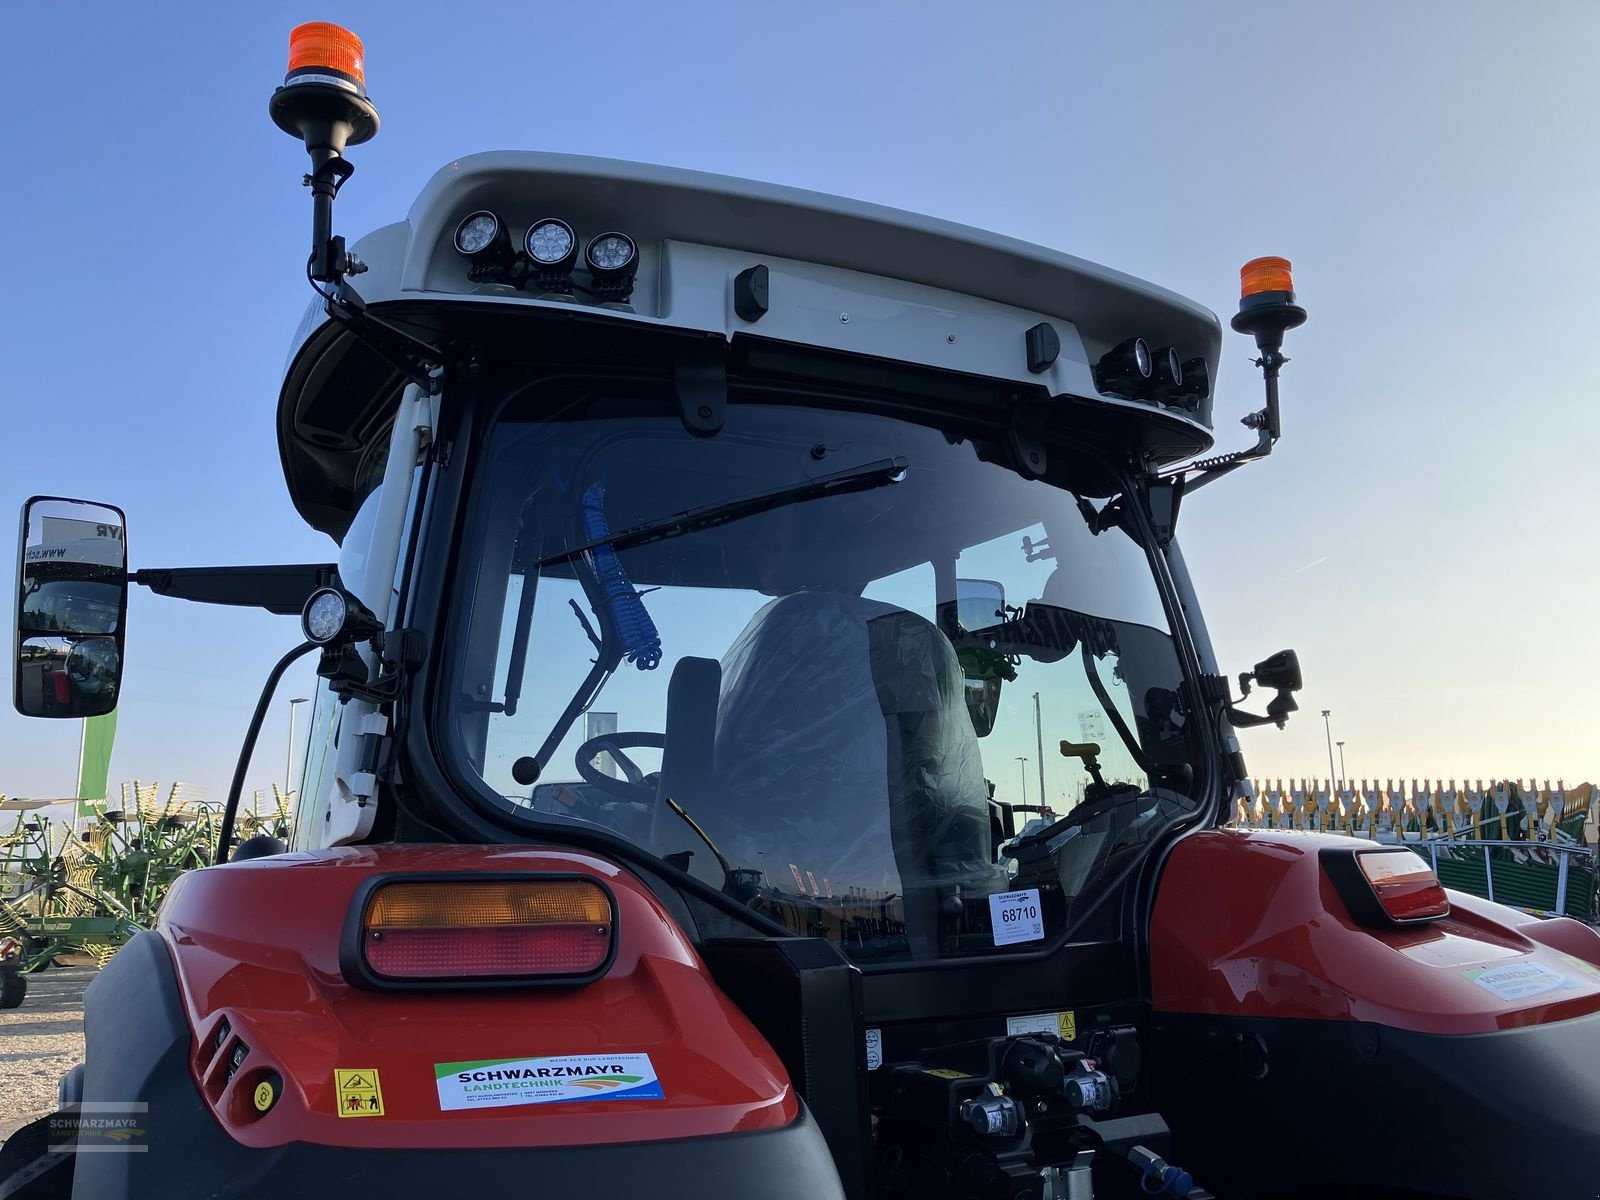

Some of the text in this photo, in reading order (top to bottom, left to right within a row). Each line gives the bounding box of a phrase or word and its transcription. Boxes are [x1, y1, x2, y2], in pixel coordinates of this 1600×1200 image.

[1002, 905, 1037, 923] 68710
[458, 1065, 625, 1083] SCHWARZMAYR
[463, 1079, 564, 1092] LANDTECHNIK
